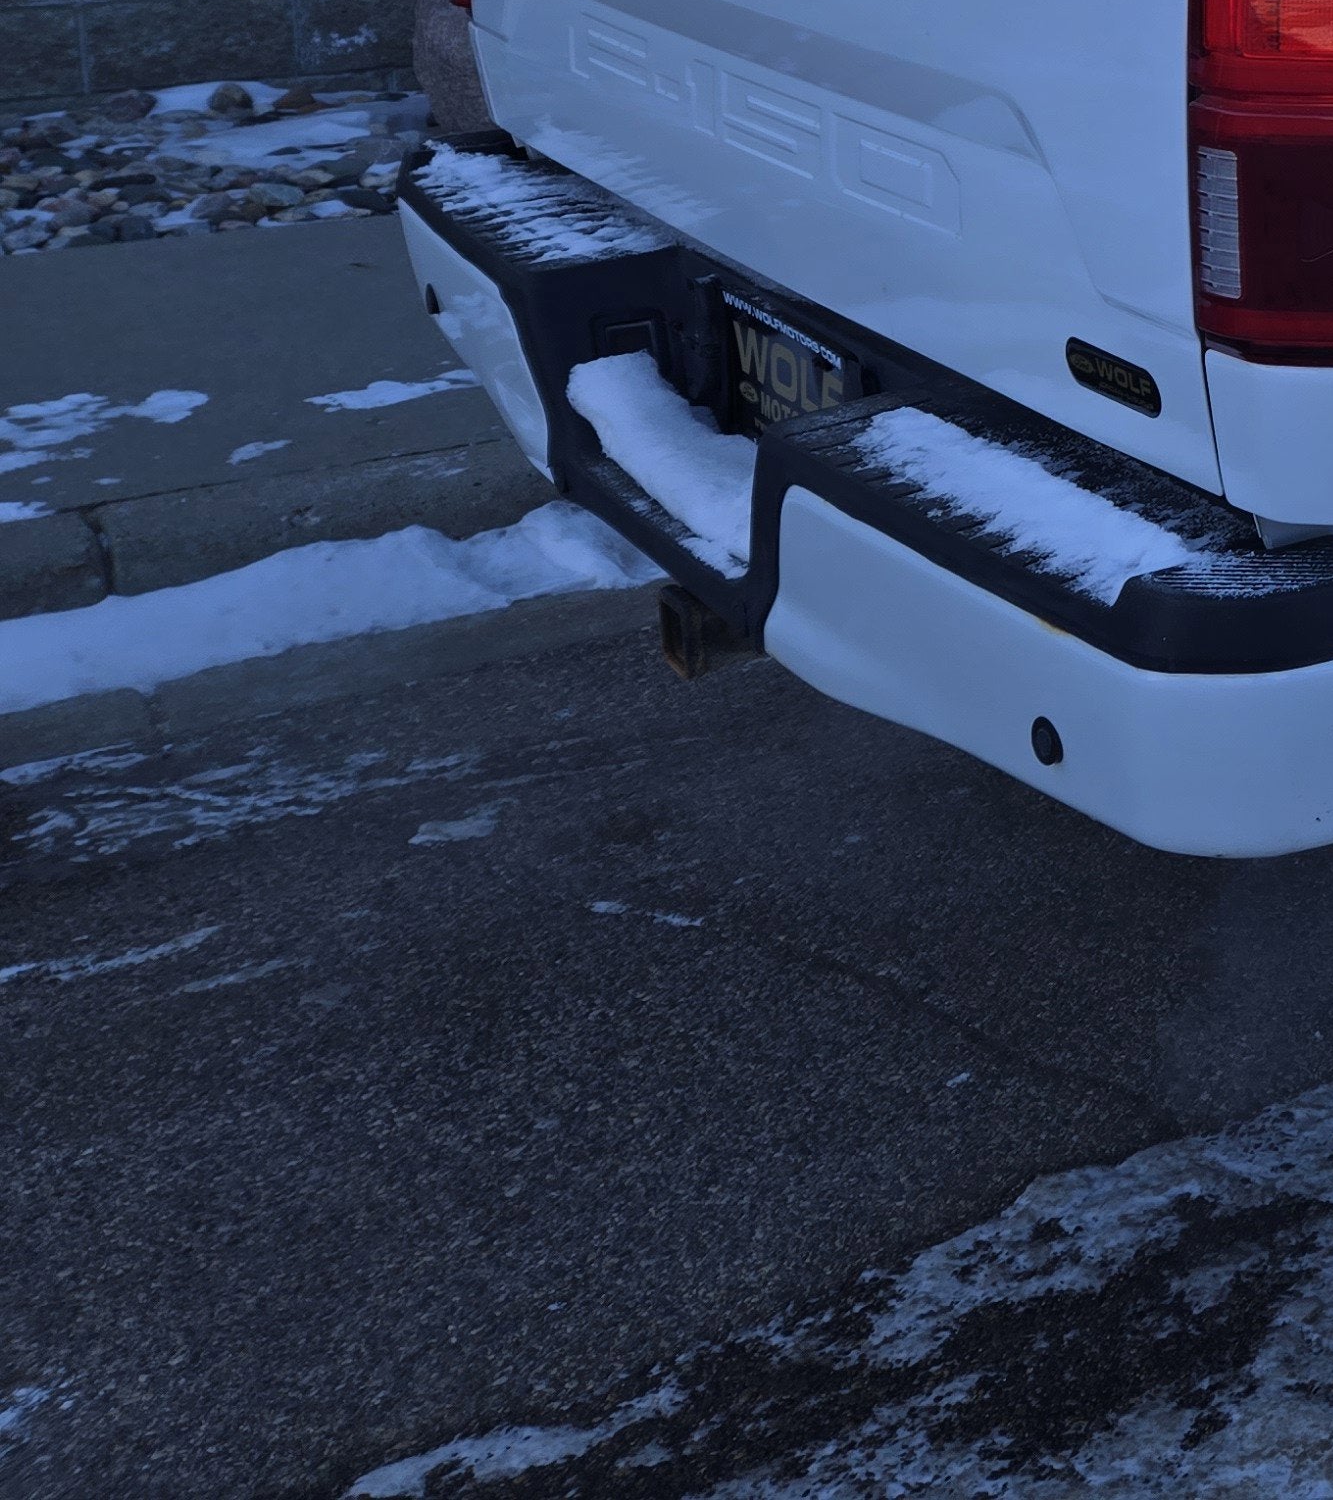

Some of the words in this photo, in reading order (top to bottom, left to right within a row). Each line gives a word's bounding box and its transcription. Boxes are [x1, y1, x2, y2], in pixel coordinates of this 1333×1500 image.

[733, 320, 844, 412] WOLF
[1095, 357, 1151, 396] WOLF
[761, 390, 799, 422] MOT
